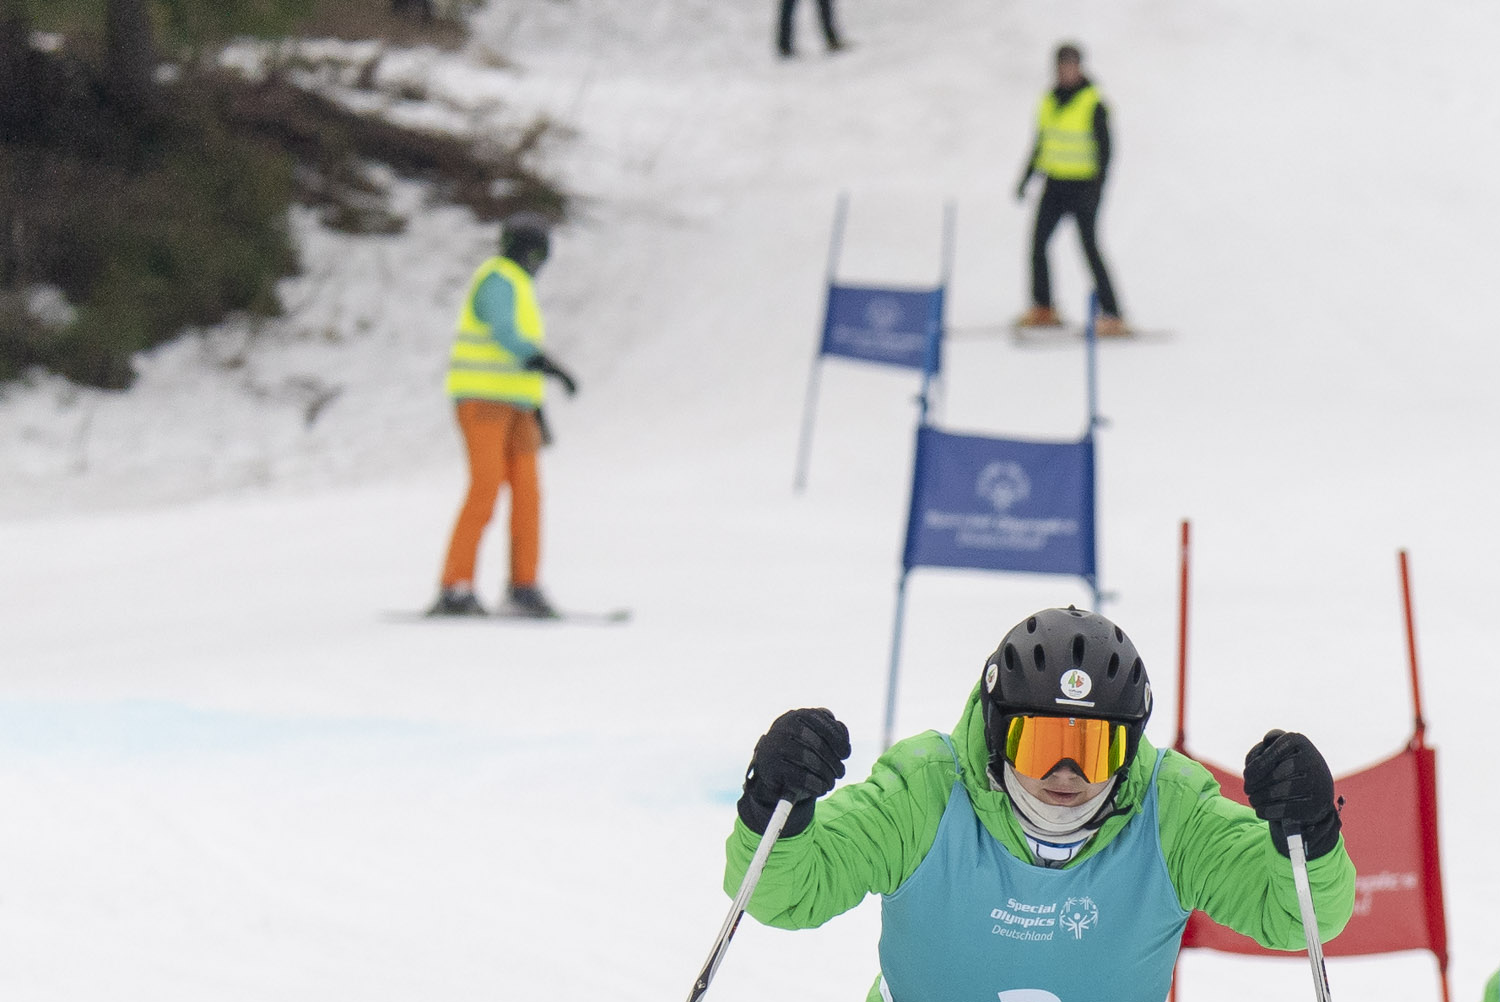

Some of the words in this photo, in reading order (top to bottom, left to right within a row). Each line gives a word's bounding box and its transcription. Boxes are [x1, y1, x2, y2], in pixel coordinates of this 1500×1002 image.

[1007, 898, 1056, 914] Special
[990, 908, 1055, 928] Olympics
[991, 924, 1053, 941] Deutschland
